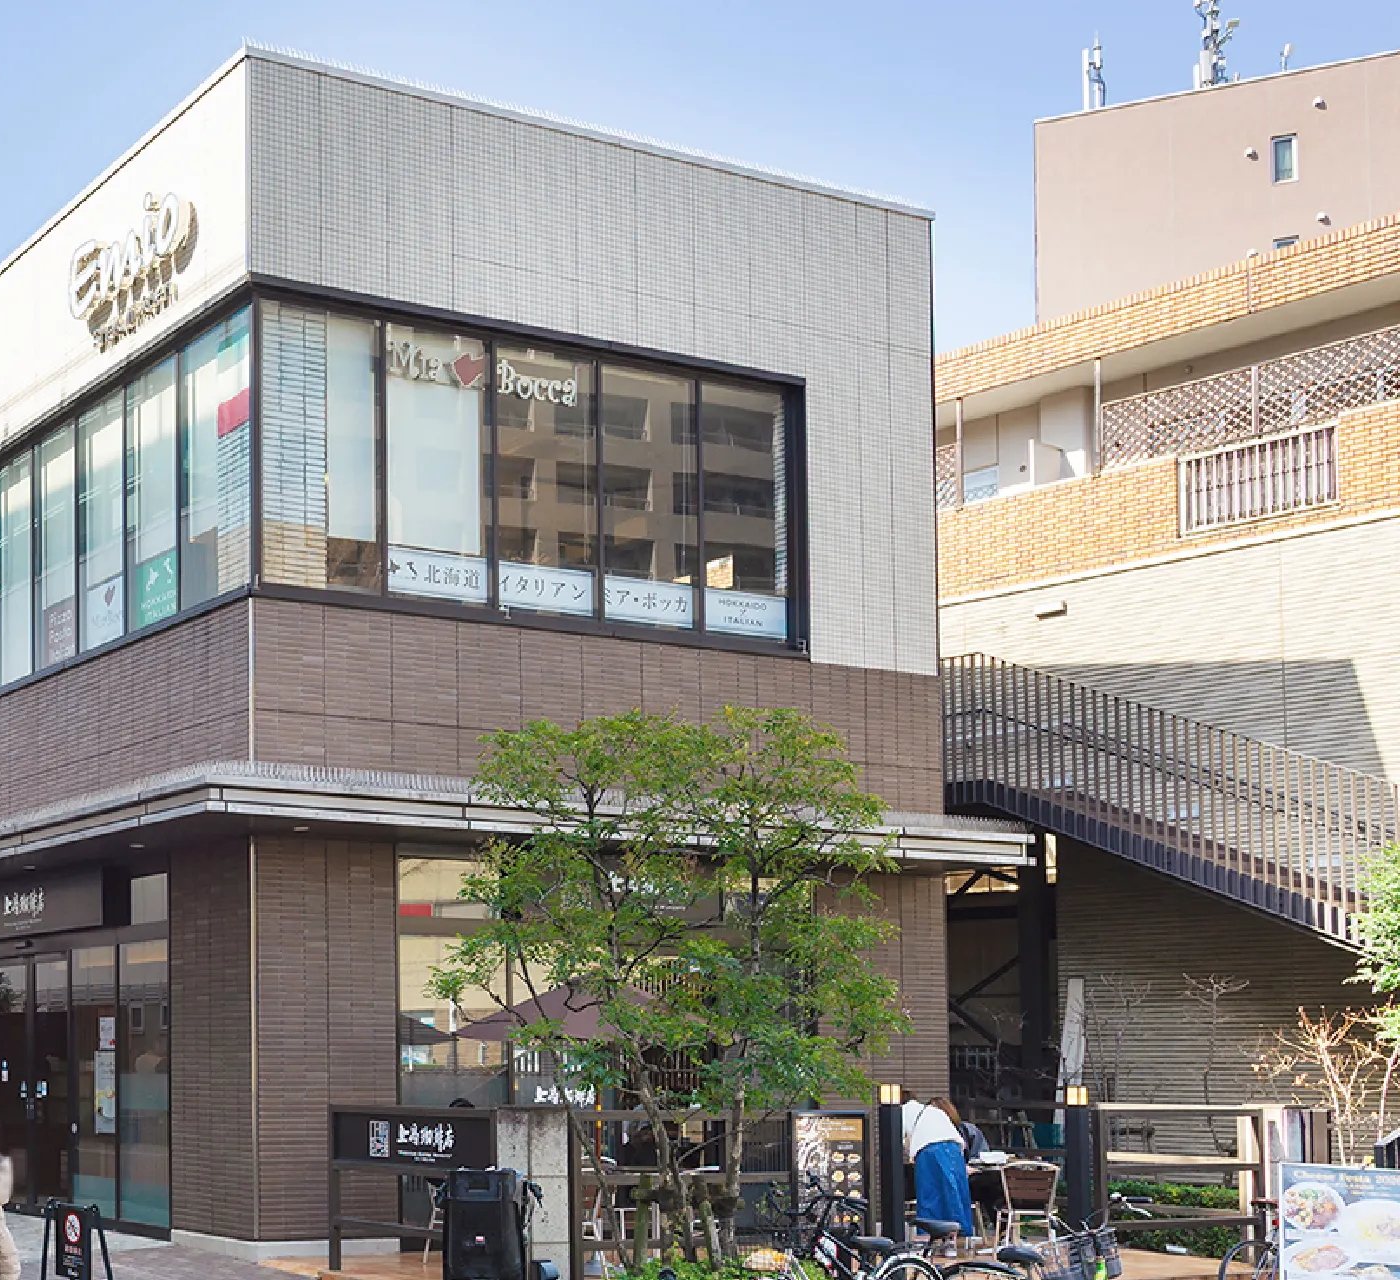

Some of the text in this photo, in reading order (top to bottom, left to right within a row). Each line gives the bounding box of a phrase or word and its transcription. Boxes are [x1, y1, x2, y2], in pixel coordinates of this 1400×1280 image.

[68, 191, 182, 321] Emio
[387, 340, 578, 408] Mia Bocca
[424, 563, 481, 591] 北海道
[501, 574, 587, 601] イタリアン
[718, 598, 767, 611] HOKKAIDO
[724, 616, 764, 627] ITALIAN
